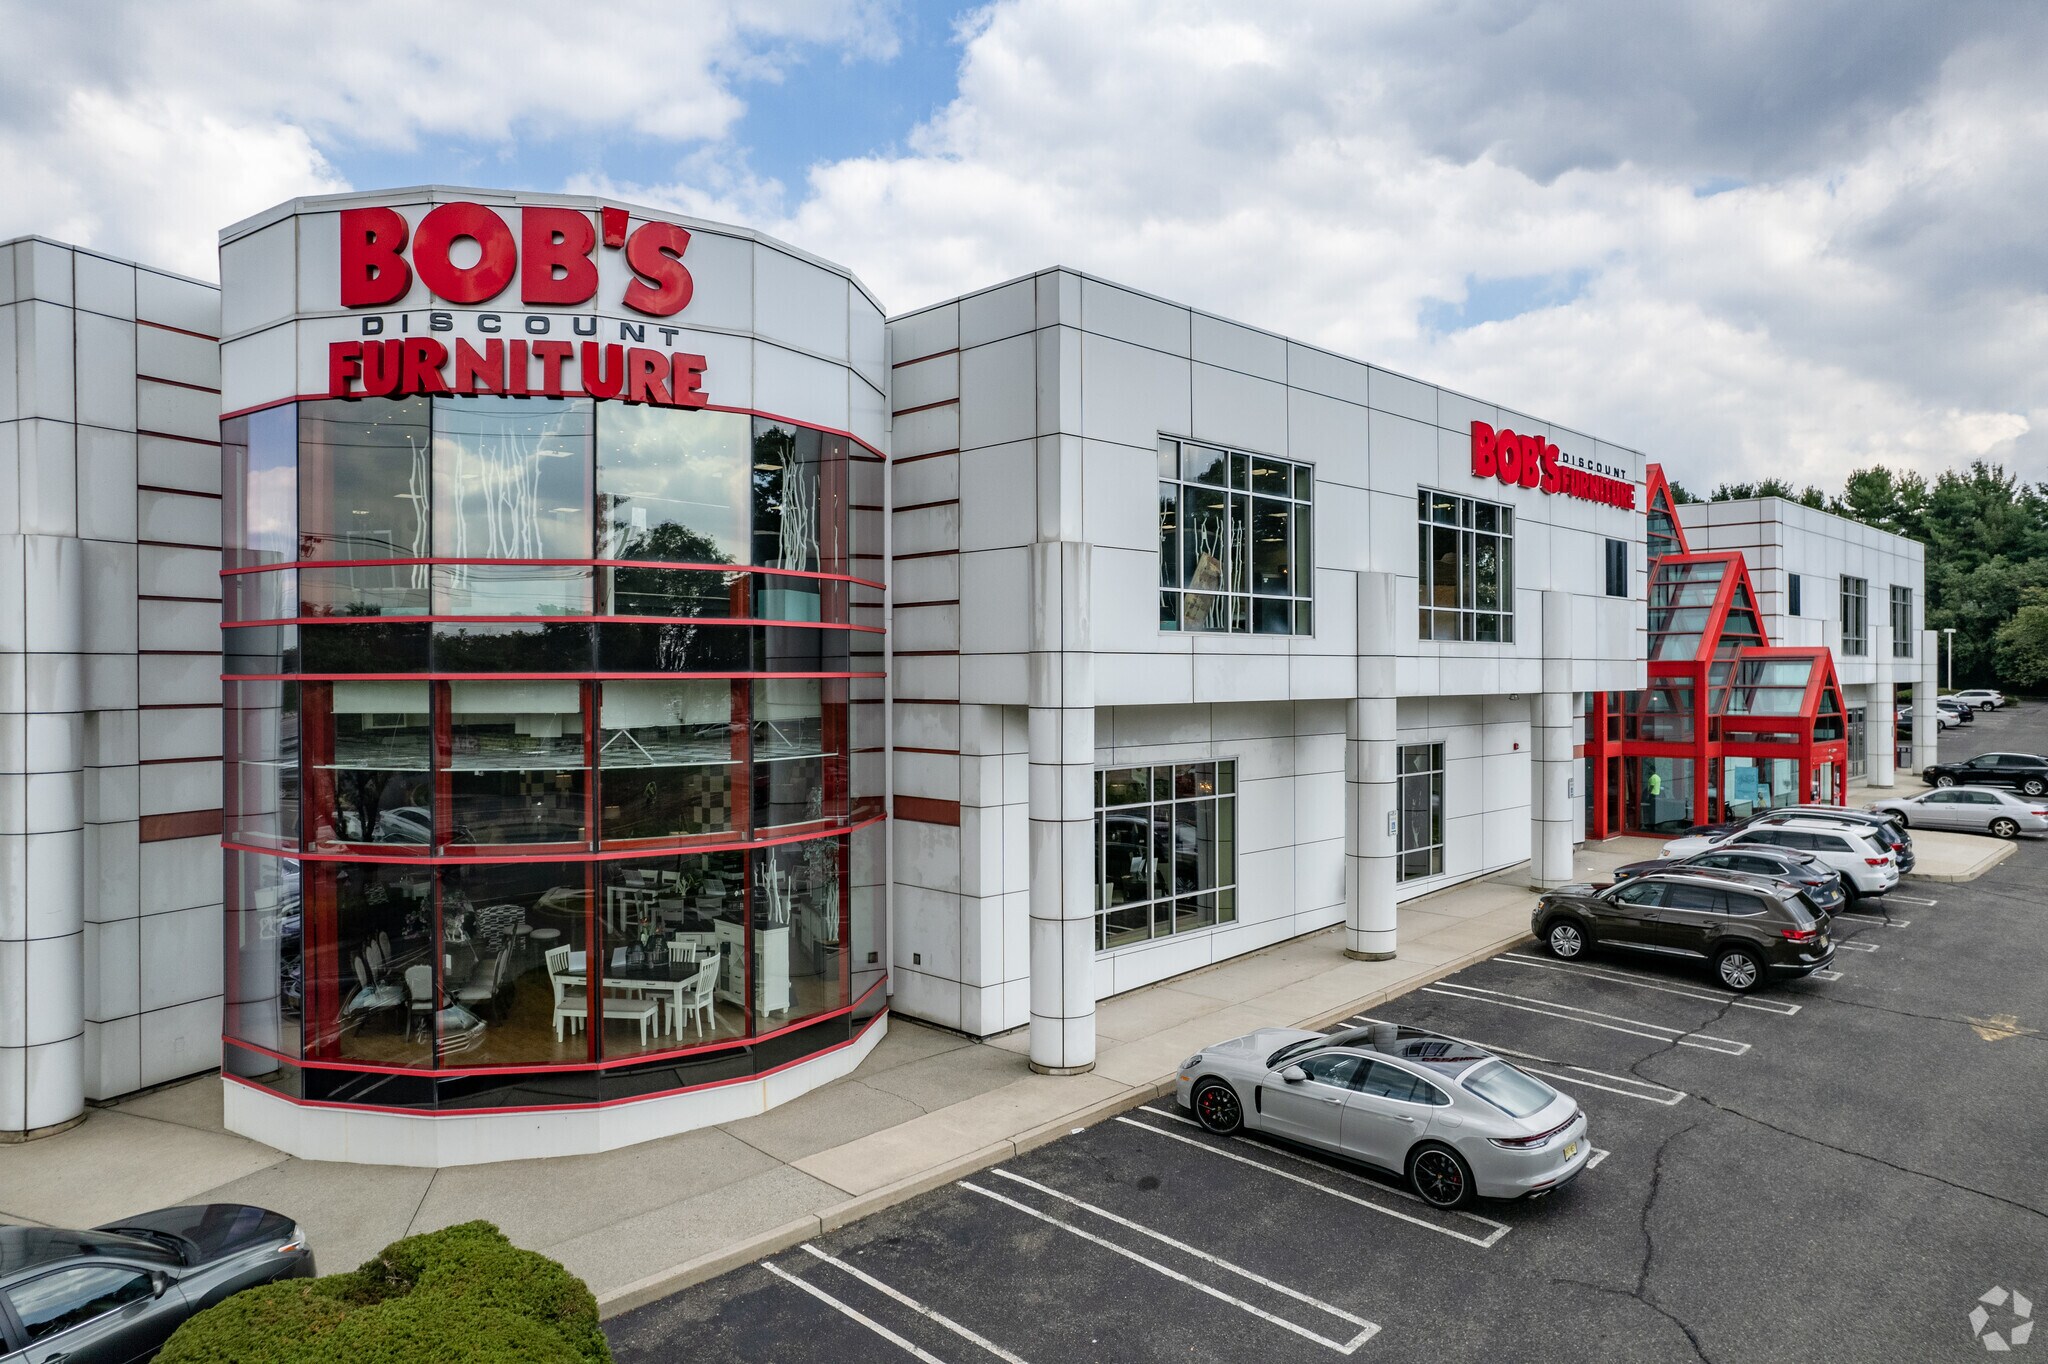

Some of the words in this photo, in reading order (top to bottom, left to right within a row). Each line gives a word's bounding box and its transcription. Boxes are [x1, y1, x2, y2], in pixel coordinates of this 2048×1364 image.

[340, 201, 694, 317] BOB'S
[362, 312, 680, 347] DISCOUNT
[329, 337, 709, 411] FURNITURE
[1471, 420, 1561, 495] BOB'S
[1562, 452, 1626, 480] DISCOUNT
[1559, 466, 1636, 510] FURNITURE
